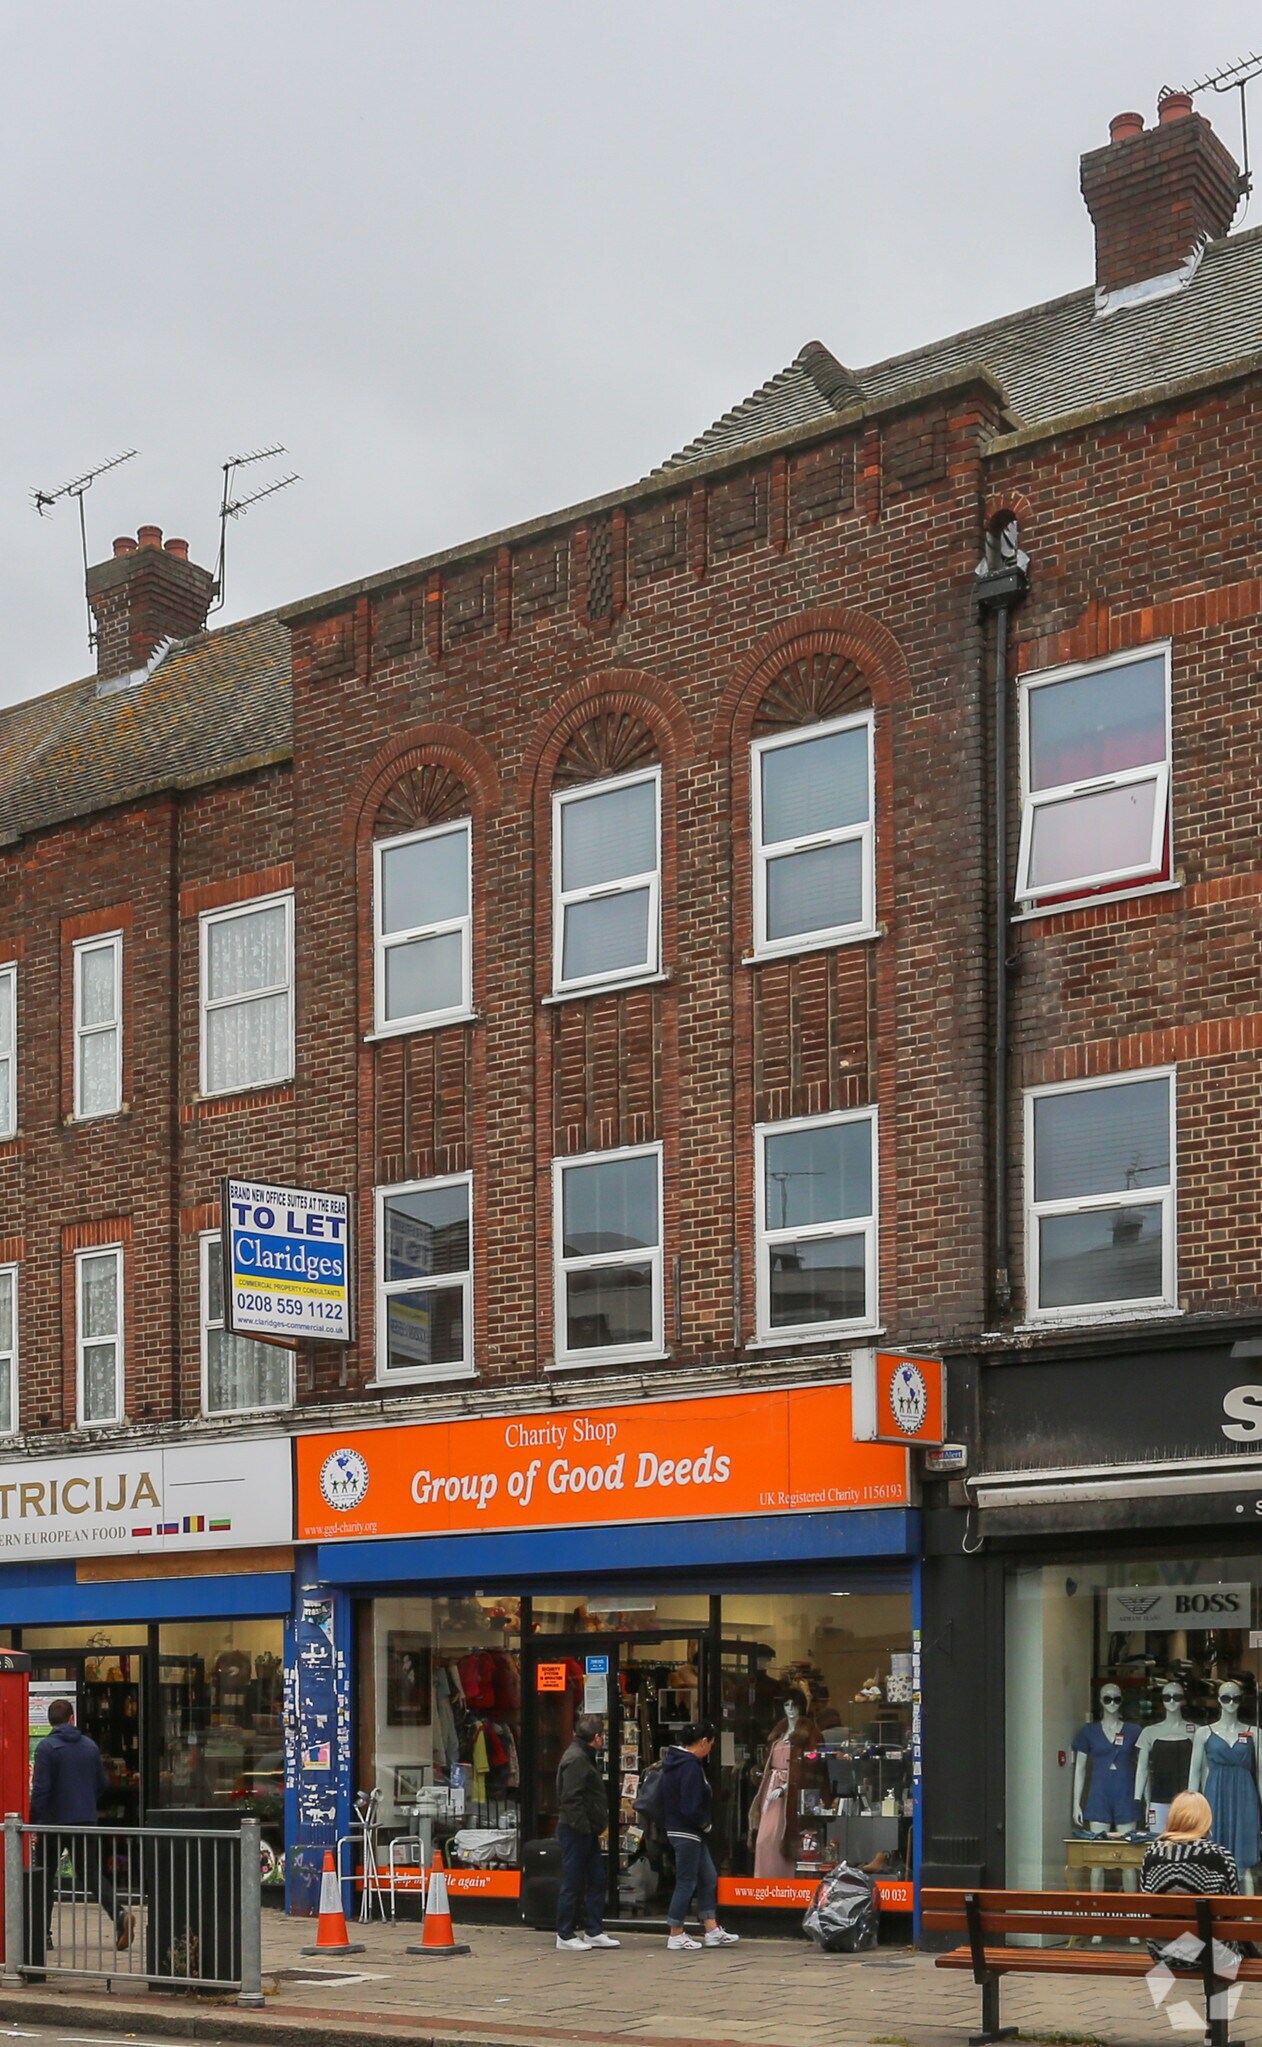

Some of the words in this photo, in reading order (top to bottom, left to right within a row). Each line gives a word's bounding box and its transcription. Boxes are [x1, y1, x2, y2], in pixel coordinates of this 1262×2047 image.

[230, 1185, 251, 1200] BRAND
[251, 1188, 265, 1202] NEW
[266, 1191, 286, 1206] OFFICE
[287, 1194, 308, 1209] SUITES
[308, 1197, 317, 1210] AT
[318, 1199, 329, 1212] THE
[330, 1200, 346, 1214] REAR
[232, 1203, 275, 1229] TO
[287, 1211, 346, 1239] LET
[235, 1237, 343, 1281] Claridges
[238, 1279, 272, 1289] COMMERCIAL
[274, 1283, 301, 1293] PROPERTY
[303, 1286, 341, 1297] CONSULTANTS
[237, 1293, 272, 1312] 0208
[277, 1297, 303, 1316] 559
[308, 1301, 343, 1320] 1122
[237, 1316, 345, 1334] www.claridges-commercial.co.uk
[505, 1420, 568, 1450] Charity
[573, 1417, 617, 1446] Shop
[411, 1470, 498, 1509] Group
[507, 1459, 541, 1506] of
[547, 1453, 626, 1494] Good
[634, 1446, 731, 1489] Deeds
[759, 1492, 775, 1506] UK
[778, 1487, 825, 1507] Registered
[827, 1486, 860, 1503] Charity
[863, 1484, 902, 1499] 1156193
[24, 1528, 89, 1545] EUROPEAN
[92, 1526, 126, 1540] FOOD
[304, 1520, 377, 1537] www.ggd-charity.org
[1175, 1593, 1240, 1614] BOSS
[735, 1885, 811, 1901] www.ggd-charity.org
[892, 1889, 907, 1901] 032
